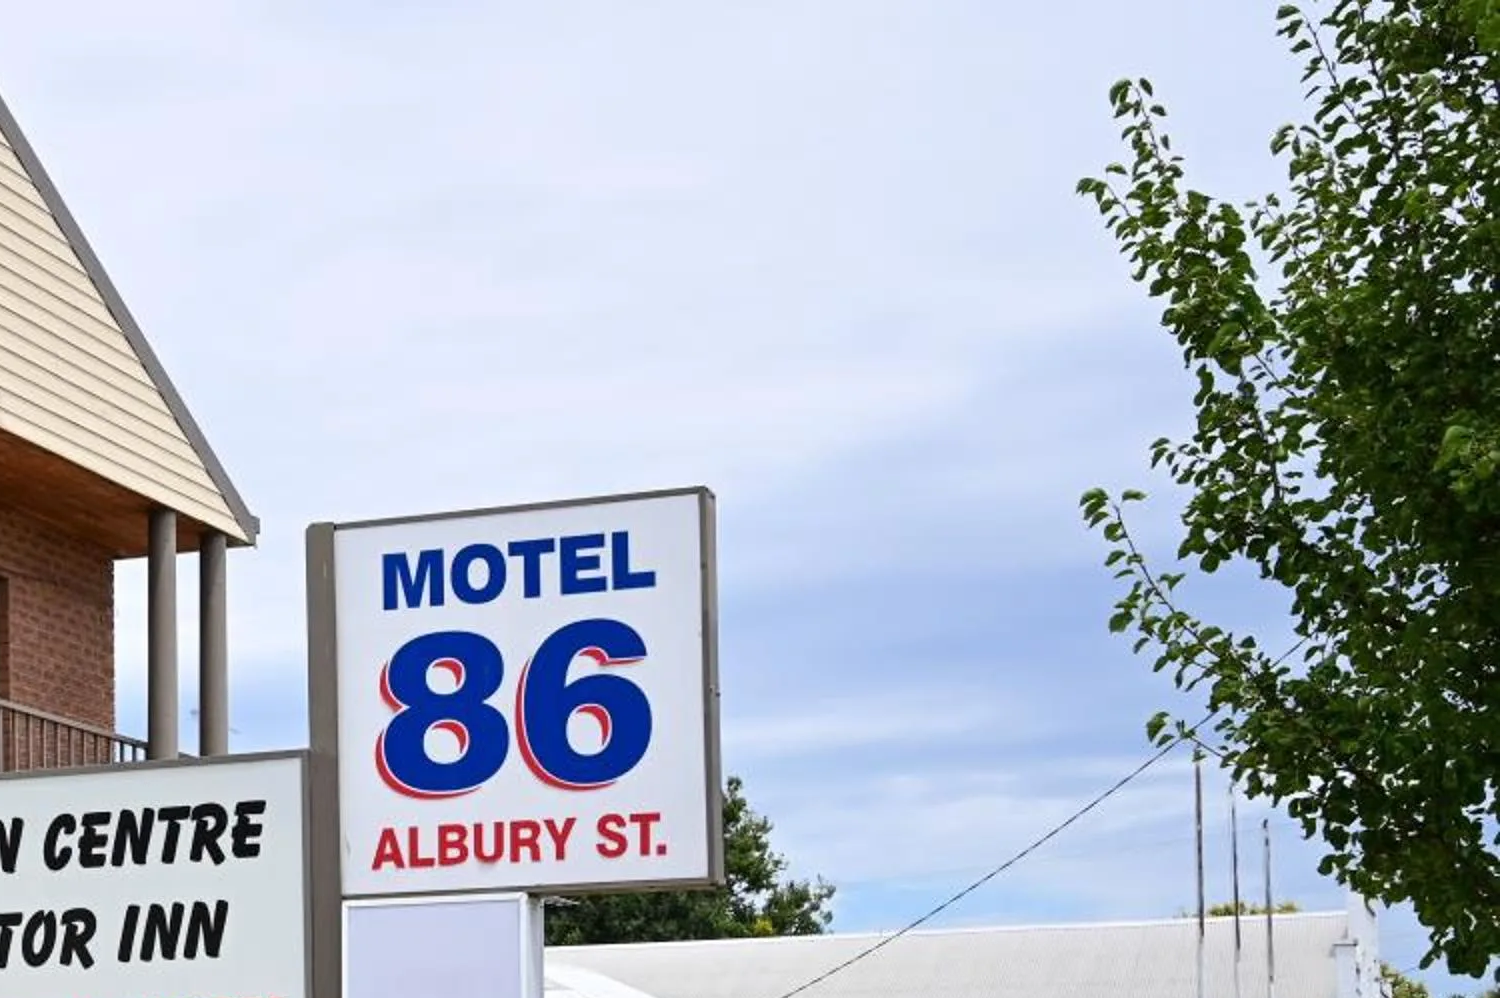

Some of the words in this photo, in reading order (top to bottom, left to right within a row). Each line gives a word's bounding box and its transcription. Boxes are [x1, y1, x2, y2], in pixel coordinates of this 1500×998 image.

[381, 530, 657, 611] MOTEL
[375, 617, 653, 800] 86
[43, 800, 267, 871] CENTRE
[371, 817, 577, 871] ALBURY
[596, 812, 667, 860] ST.
[117, 899, 229, 963] INN
